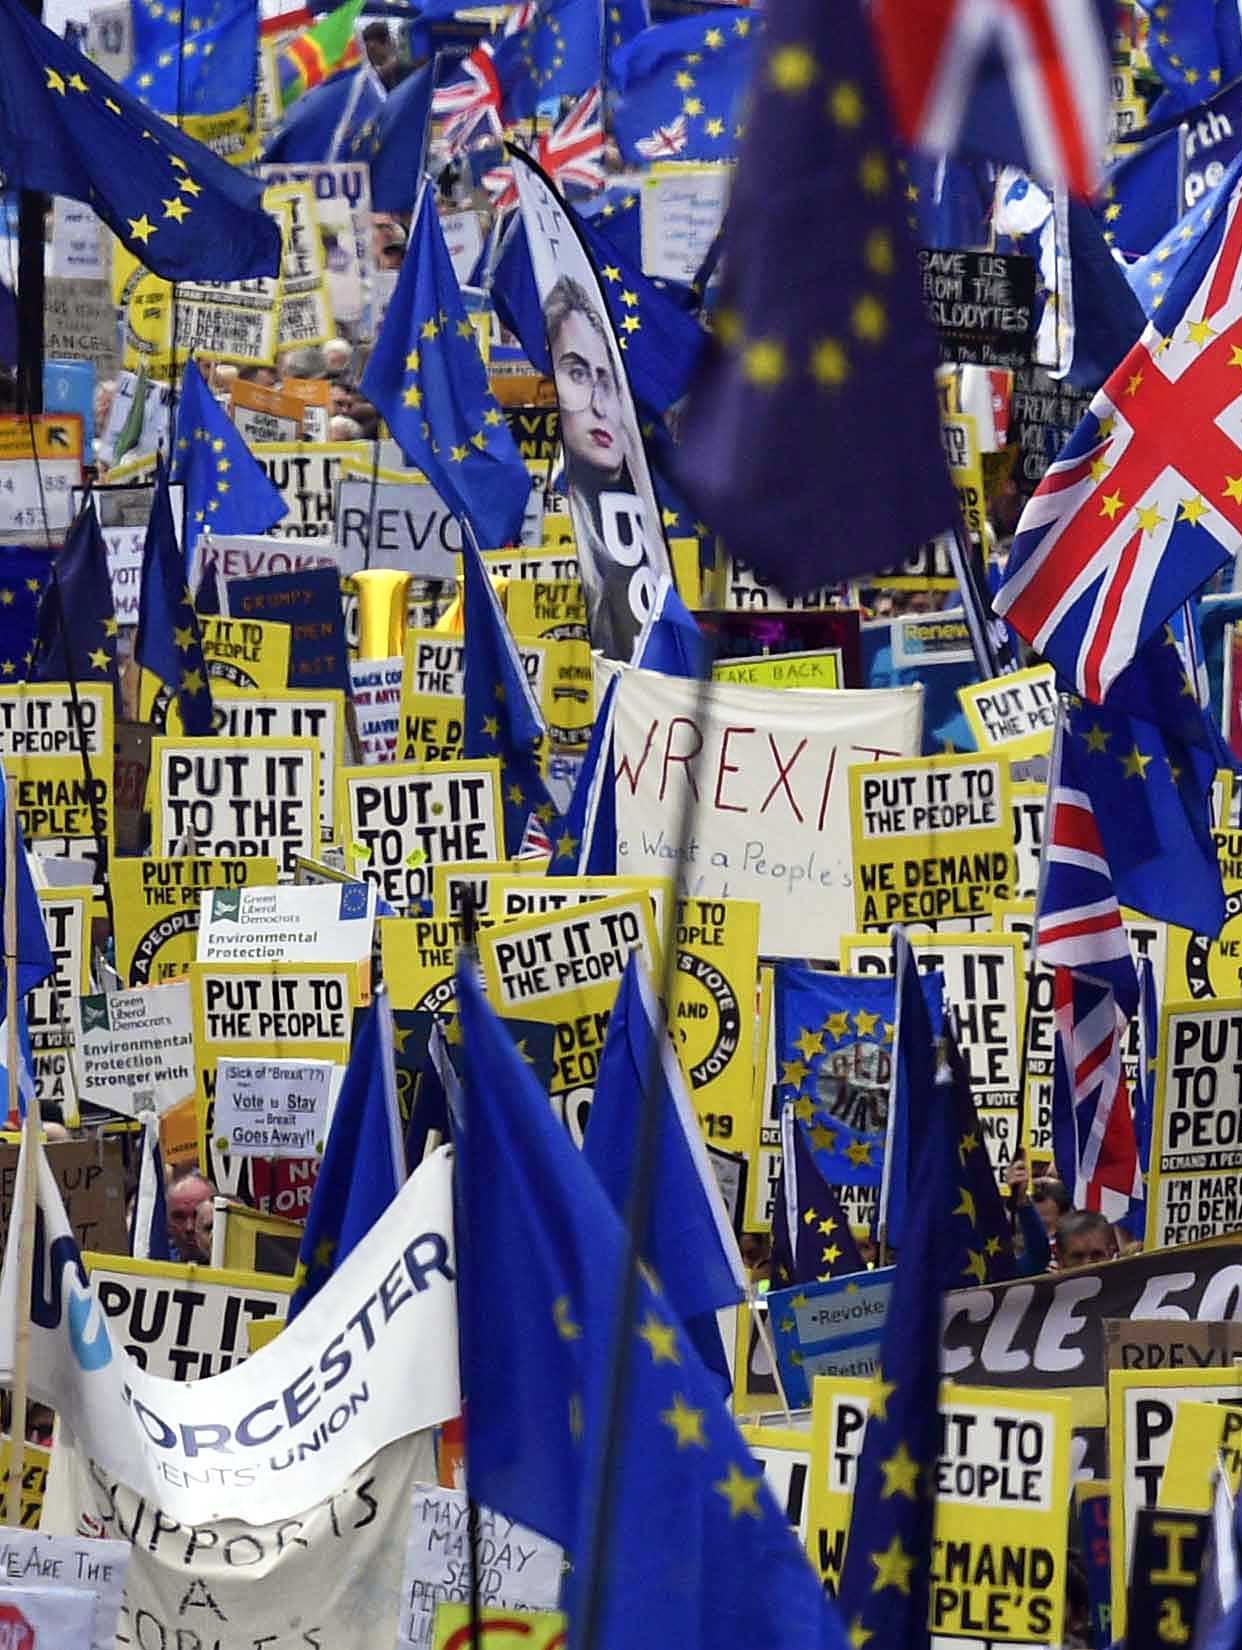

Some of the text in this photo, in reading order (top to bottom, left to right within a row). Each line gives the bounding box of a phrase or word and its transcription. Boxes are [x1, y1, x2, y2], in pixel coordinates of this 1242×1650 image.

[773, 663, 825, 682] BACK
[27, 702, 51, 729] IT
[976, 686, 1022, 720] PUT
[168, 755, 304, 797] PUT IT
[863, 769, 995, 809] PUT IT TO
[356, 778, 485, 828] PUT IT
[167, 799, 304, 838] TO THE
[864, 802, 996, 836] THE PEOPLE
[415, 823, 488, 863] THE
[143, 861, 247, 886] PUT IT TO
[742, 840, 853, 891] People's
[860, 852, 1009, 891] WE DEMAND
[241, 903, 277, 915] Liberal
[242, 893, 277, 905] Green
[863, 882, 1010, 922] A PEOPLE'S
[701, 903, 726, 926] TO
[206, 944, 285, 959] Protection
[208, 930, 319, 946] Environmental
[496, 911, 640, 975] PUT IT TO
[502, 970, 547, 1001] THE
[963, 955, 1005, 1000] IT
[206, 979, 343, 1013] PUT IT TO
[207, 1012, 346, 1039] THE PEOPLE
[83, 1032, 193, 1057] Environmental
[84, 1053, 163, 1073] Protection
[255, 1066, 266, 1079] of
[84, 1066, 190, 1090] Stronger with
[1173, 1066, 1217, 1109] TO
[232, 1093, 317, 1111] Vote Stay
[232, 1127, 315, 1148] Goes Away!!
[1161, 1153, 1208, 1172] DEMAND
[63, 1167, 103, 1191] UP
[1167, 1200, 1192, 1224] TO
[100, 1281, 209, 1347] PUT
[818, 1299, 885, 1326] Revoke
[269, 1381, 371, 1473] UNION
[993, 1417, 1045, 1466] TO
